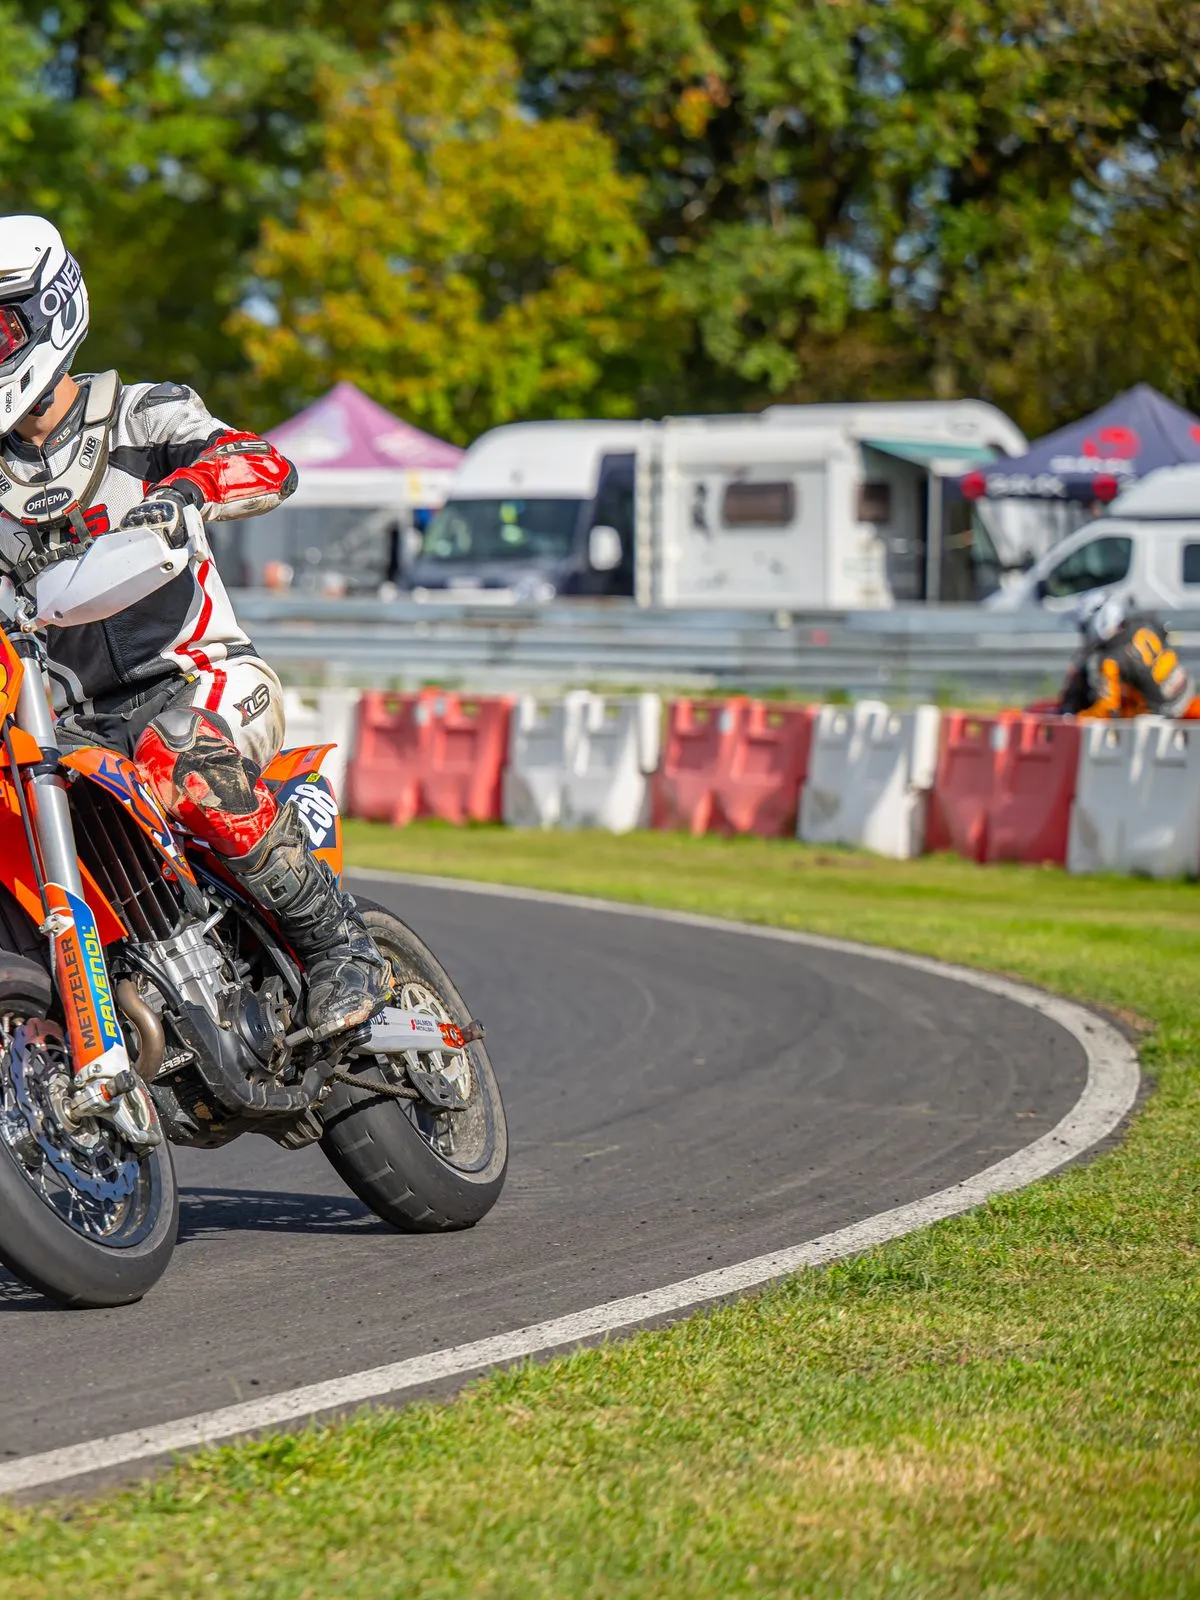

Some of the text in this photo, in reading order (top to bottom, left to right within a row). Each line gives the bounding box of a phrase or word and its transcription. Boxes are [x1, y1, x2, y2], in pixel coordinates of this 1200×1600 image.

[26, 491, 70, 512] ORTEMA
[232, 683, 271, 728] XLS
[60, 936, 97, 1050] METZELER
[82, 926, 118, 1038] RAVENOL
